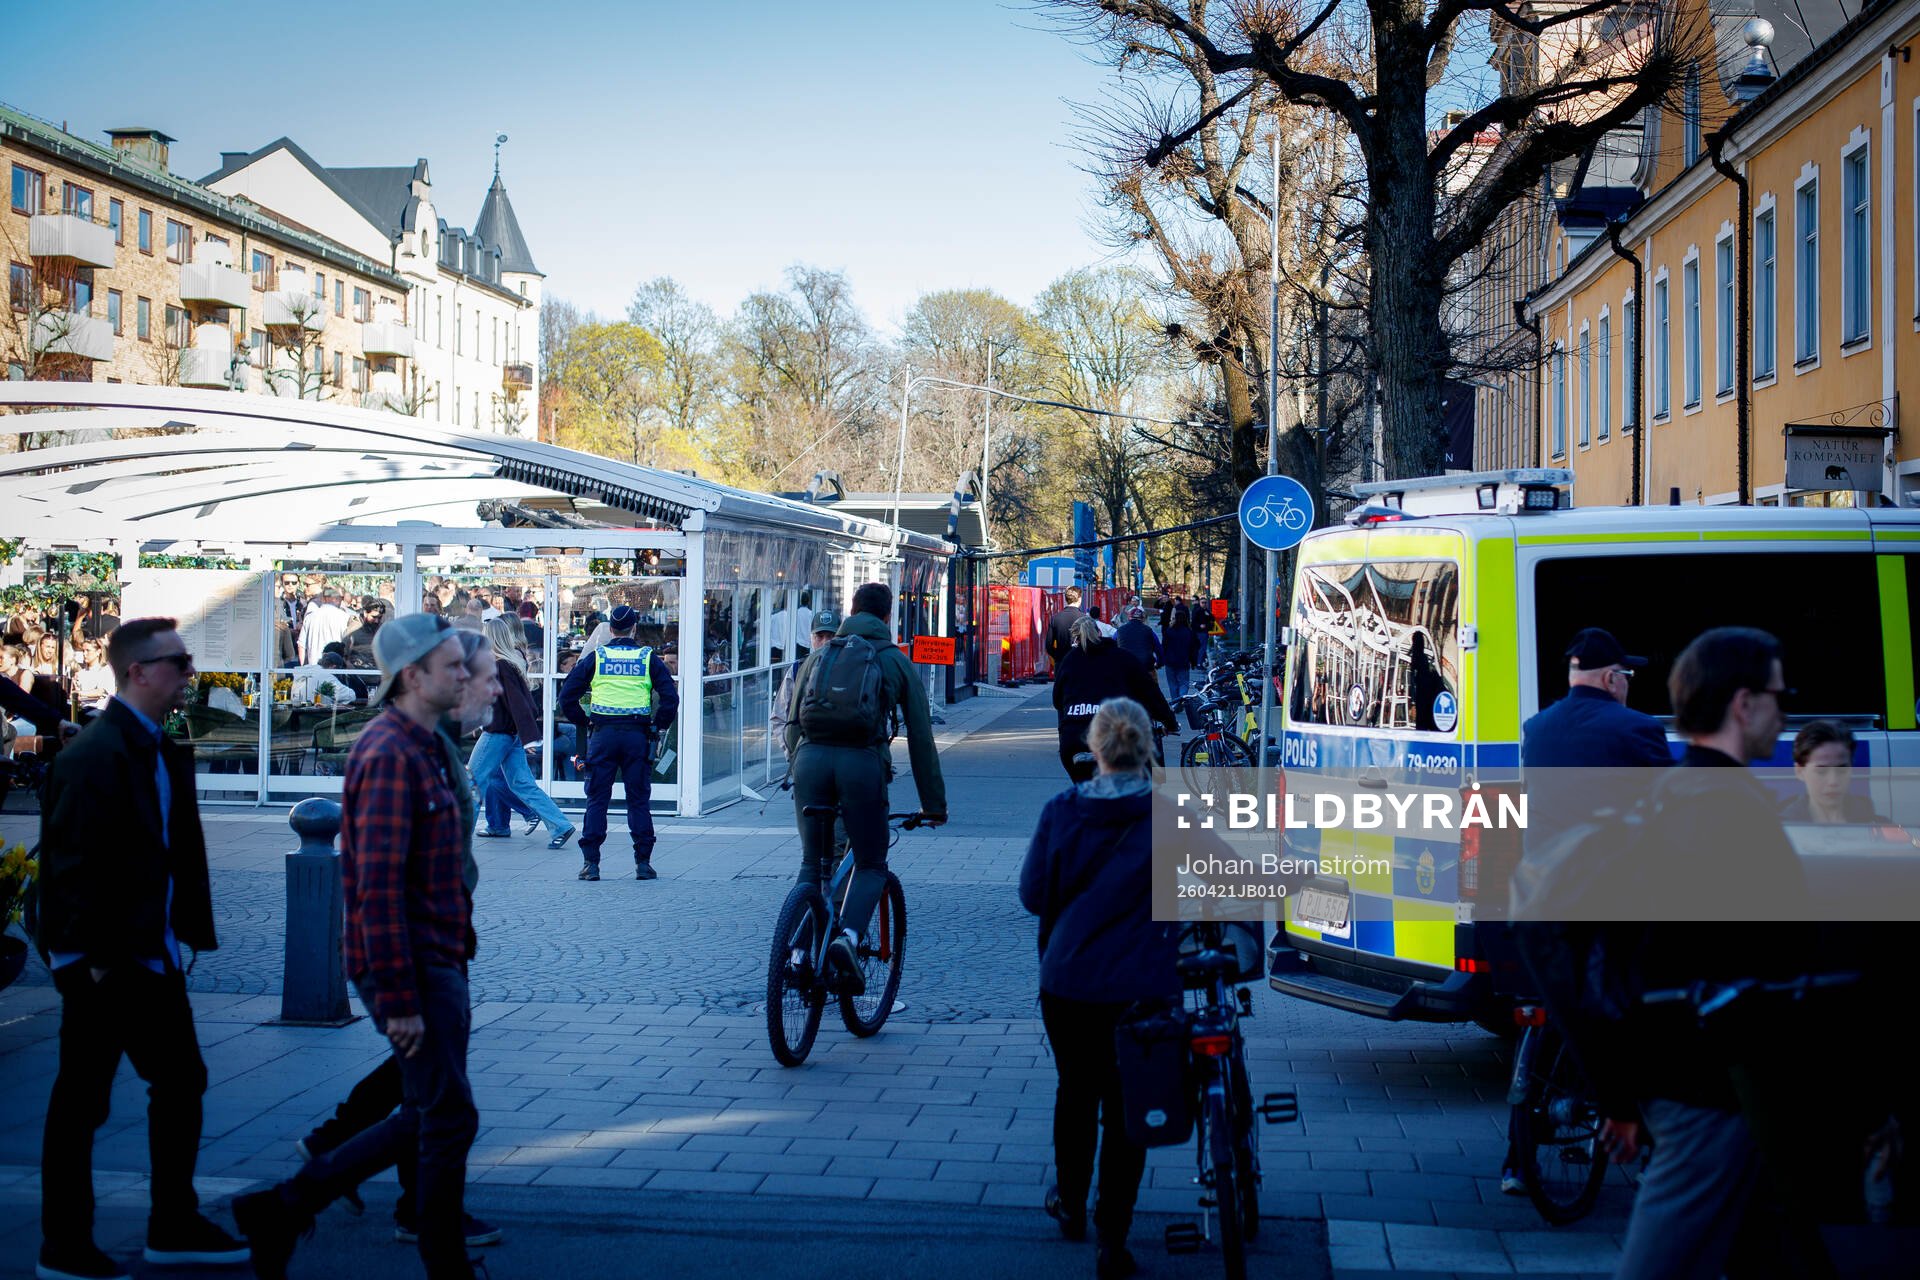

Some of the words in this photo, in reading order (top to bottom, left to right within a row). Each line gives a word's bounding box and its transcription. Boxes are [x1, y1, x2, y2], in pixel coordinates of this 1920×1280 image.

[1813, 440, 1858, 450] NATUR
[1794, 452, 1877, 463] KOMPANIET
[605, 663, 641, 675] POLIS
[1286, 738, 1317, 768] POLIS
[1407, 754, 1457, 775] 79-0230
